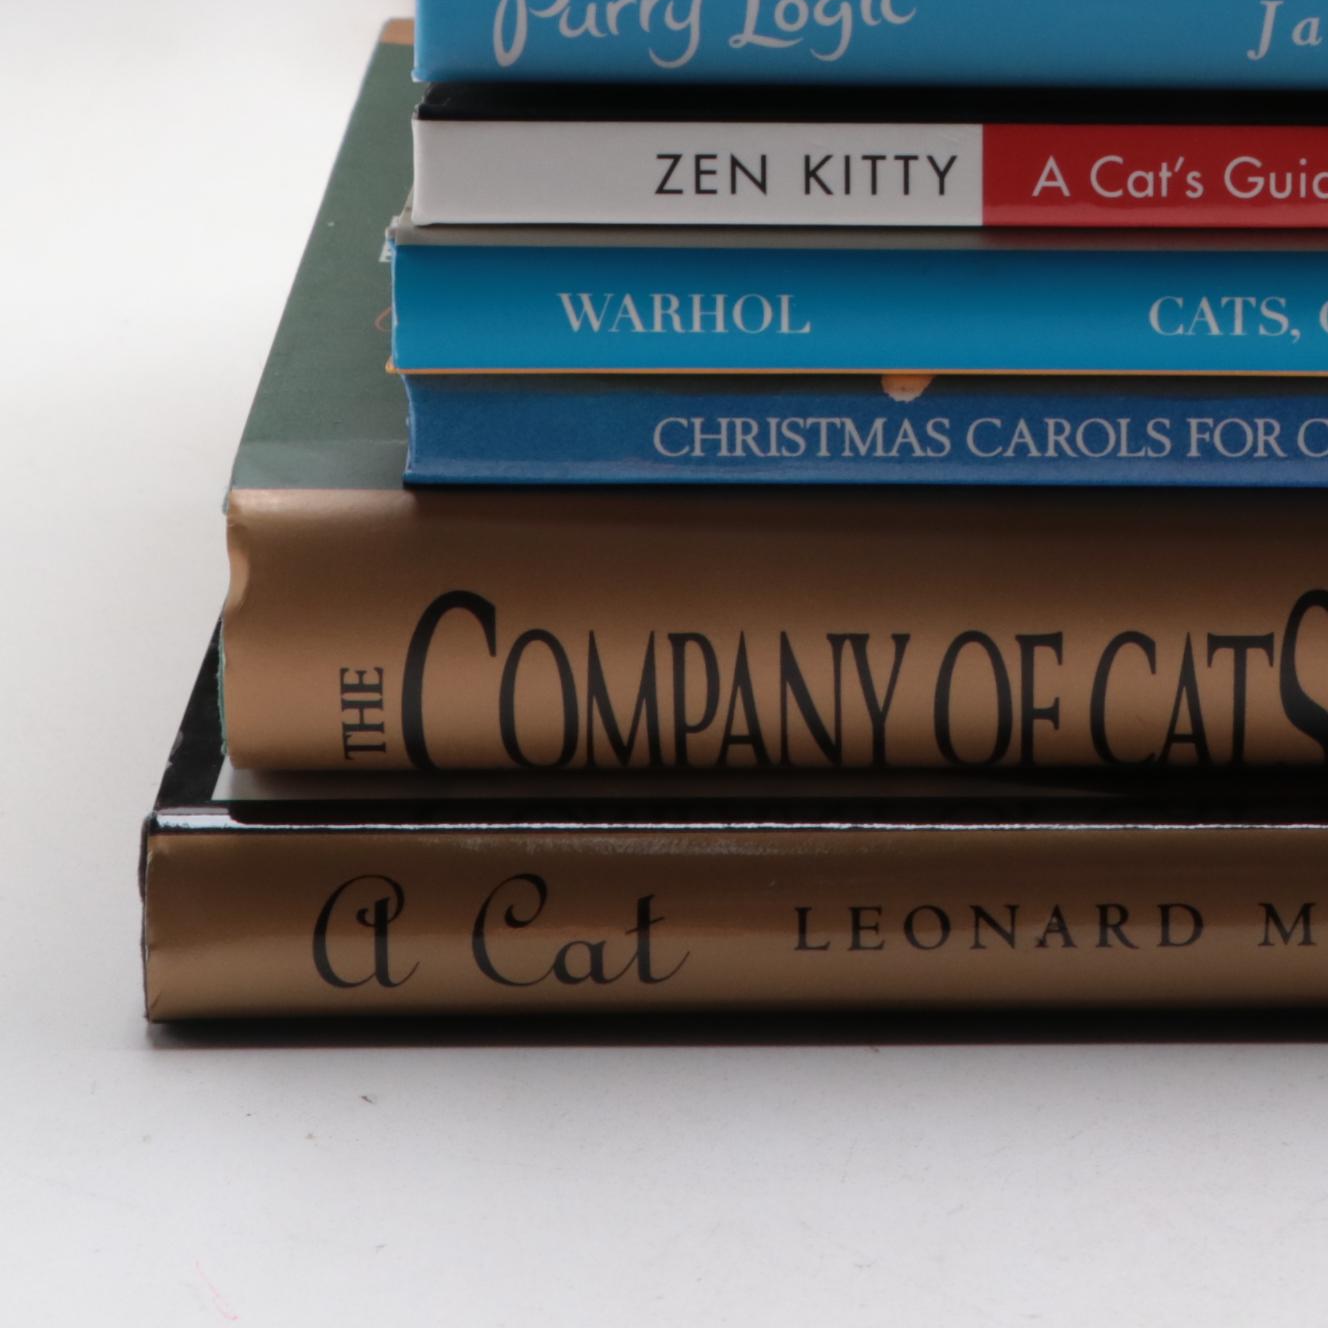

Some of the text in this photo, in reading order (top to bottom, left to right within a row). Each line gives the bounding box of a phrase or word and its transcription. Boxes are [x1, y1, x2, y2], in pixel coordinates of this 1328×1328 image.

[654, 154, 958, 197] ZEN KITTY
[1031, 155, 1071, 198] A
[1090, 155, 1204, 200] Cat's
[560, 293, 811, 334] WARHOL
[1148, 295, 1301, 342] CATS,
[653, 417, 951, 458] CHRISTMAS
[966, 418, 1171, 458] CAROLS
[1186, 418, 1287, 458] FOR
[339, 666, 387, 761] THE
[401, 589, 911, 770] COMPANY
[933, 629, 1064, 769] OF
[312, 873, 691, 989] A Cat
[794, 903, 1205, 952] LEONARD
